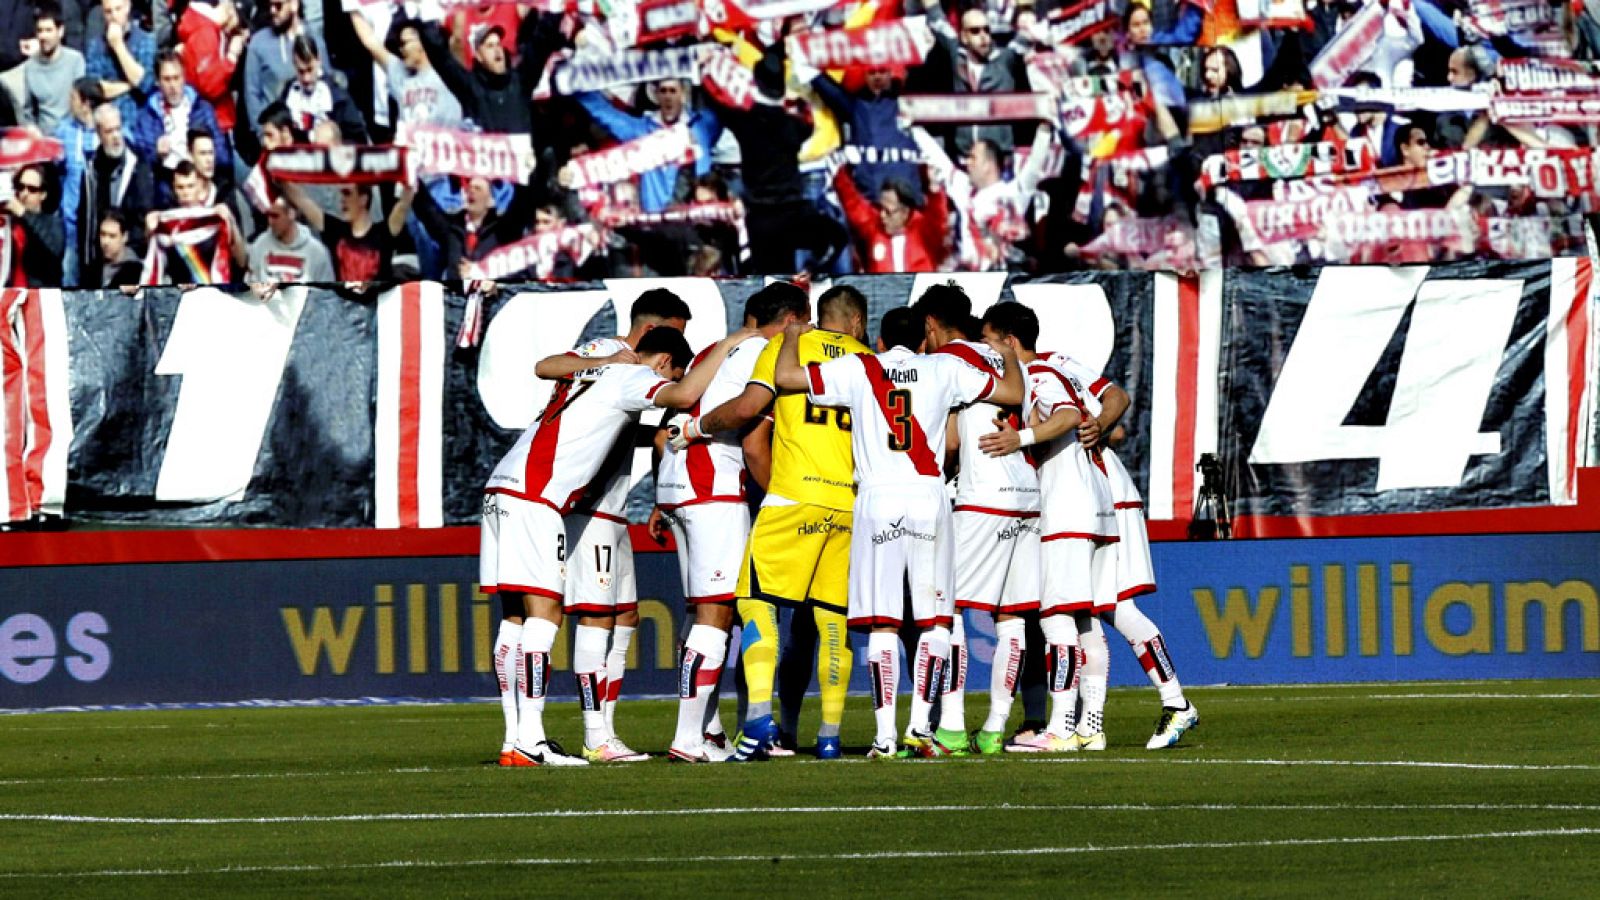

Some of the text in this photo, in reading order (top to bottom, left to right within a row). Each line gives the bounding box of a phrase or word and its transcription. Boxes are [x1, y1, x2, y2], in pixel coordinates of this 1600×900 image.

[154, 285, 307, 501] 1
[1251, 265, 1525, 492] 4
[882, 368, 918, 383] NACHO
[887, 389, 912, 453] 3
[595, 545, 612, 572] 17
[1191, 563, 1600, 659] william
[0, 611, 112, 684] es
